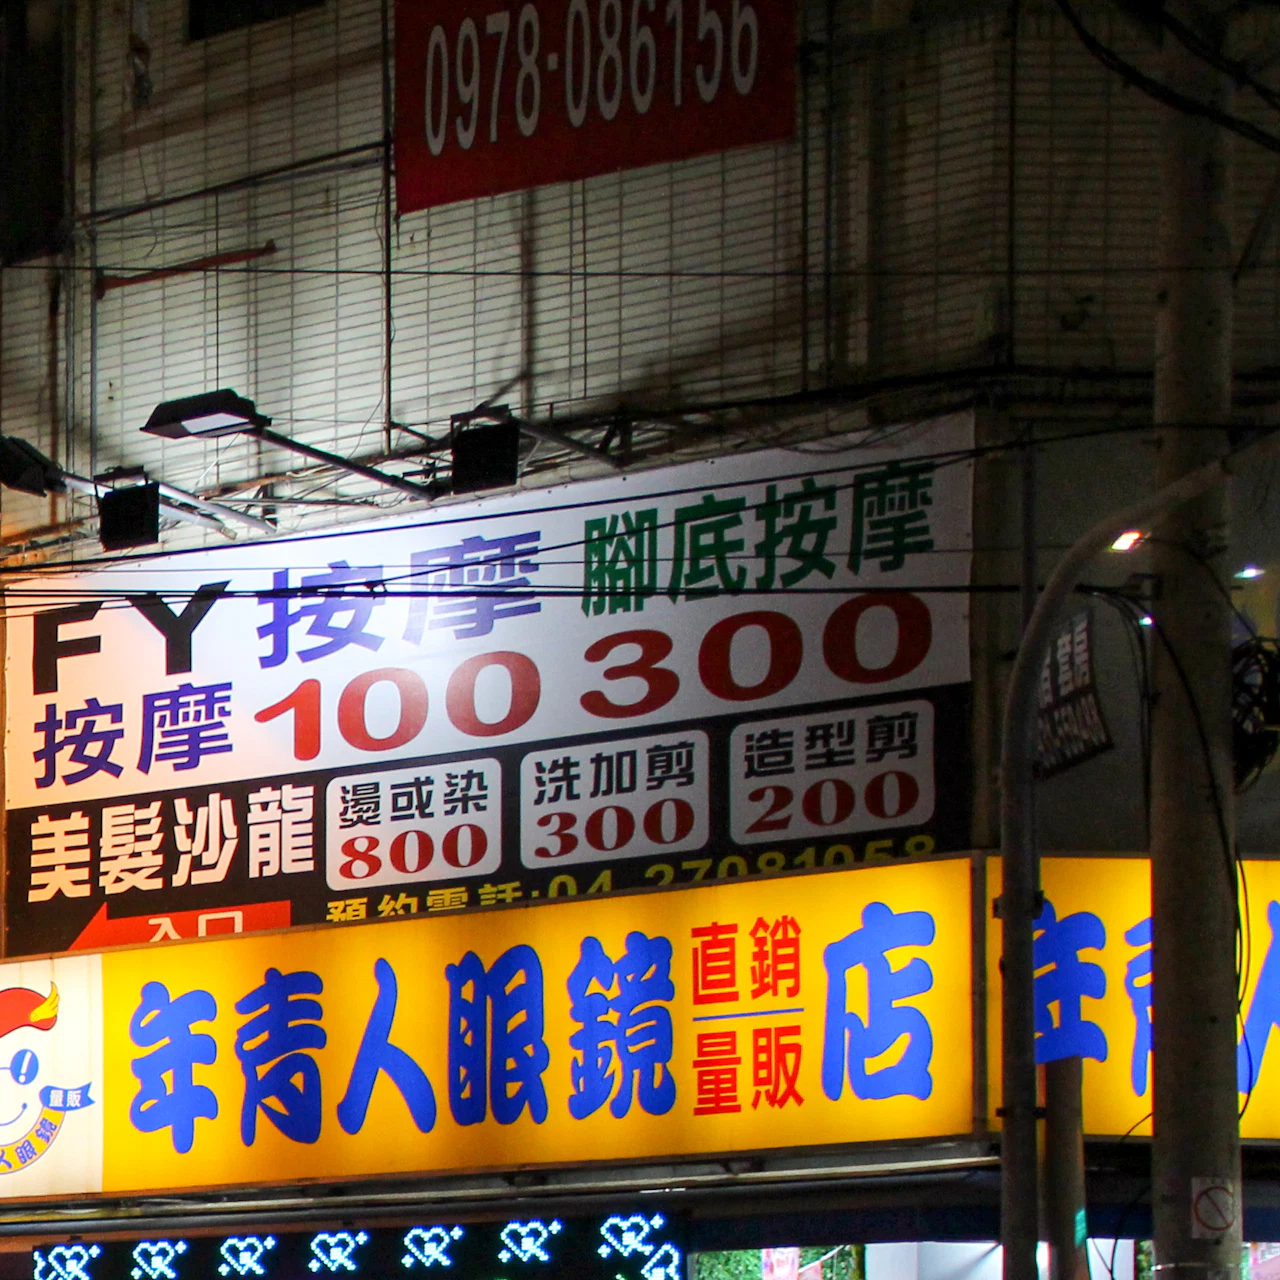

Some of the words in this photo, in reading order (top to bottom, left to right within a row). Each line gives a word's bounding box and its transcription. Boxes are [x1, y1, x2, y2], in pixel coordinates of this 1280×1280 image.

[424, 0, 760, 157] 0978-086156
[32, 579, 232, 696] FY
[255, 529, 542, 670] 按摩
[580, 460, 935, 618] 腳底按摩
[33, 680, 234, 789] 按摩
[253, 650, 542, 763] 100
[579, 589, 933, 720] 300
[533, 727, 696, 806] 洗加剪
[743, 709, 919, 780] 造型剪
[338, 771, 489, 831] 燙或染
[533, 795, 696, 860] 300
[744, 768, 921, 834] 200
[27, 783, 316, 903] 美髮沙龍
[338, 824, 490, 881] 800
[146, 911, 245, 942] 入口
[690, 914, 803, 1007] 直銷
[129, 930, 677, 1155] 年青人眼鏡
[820, 901, 936, 1101] 店
[49, 1089, 82, 1108] 量販
[691, 1024, 805, 1117] 量販
